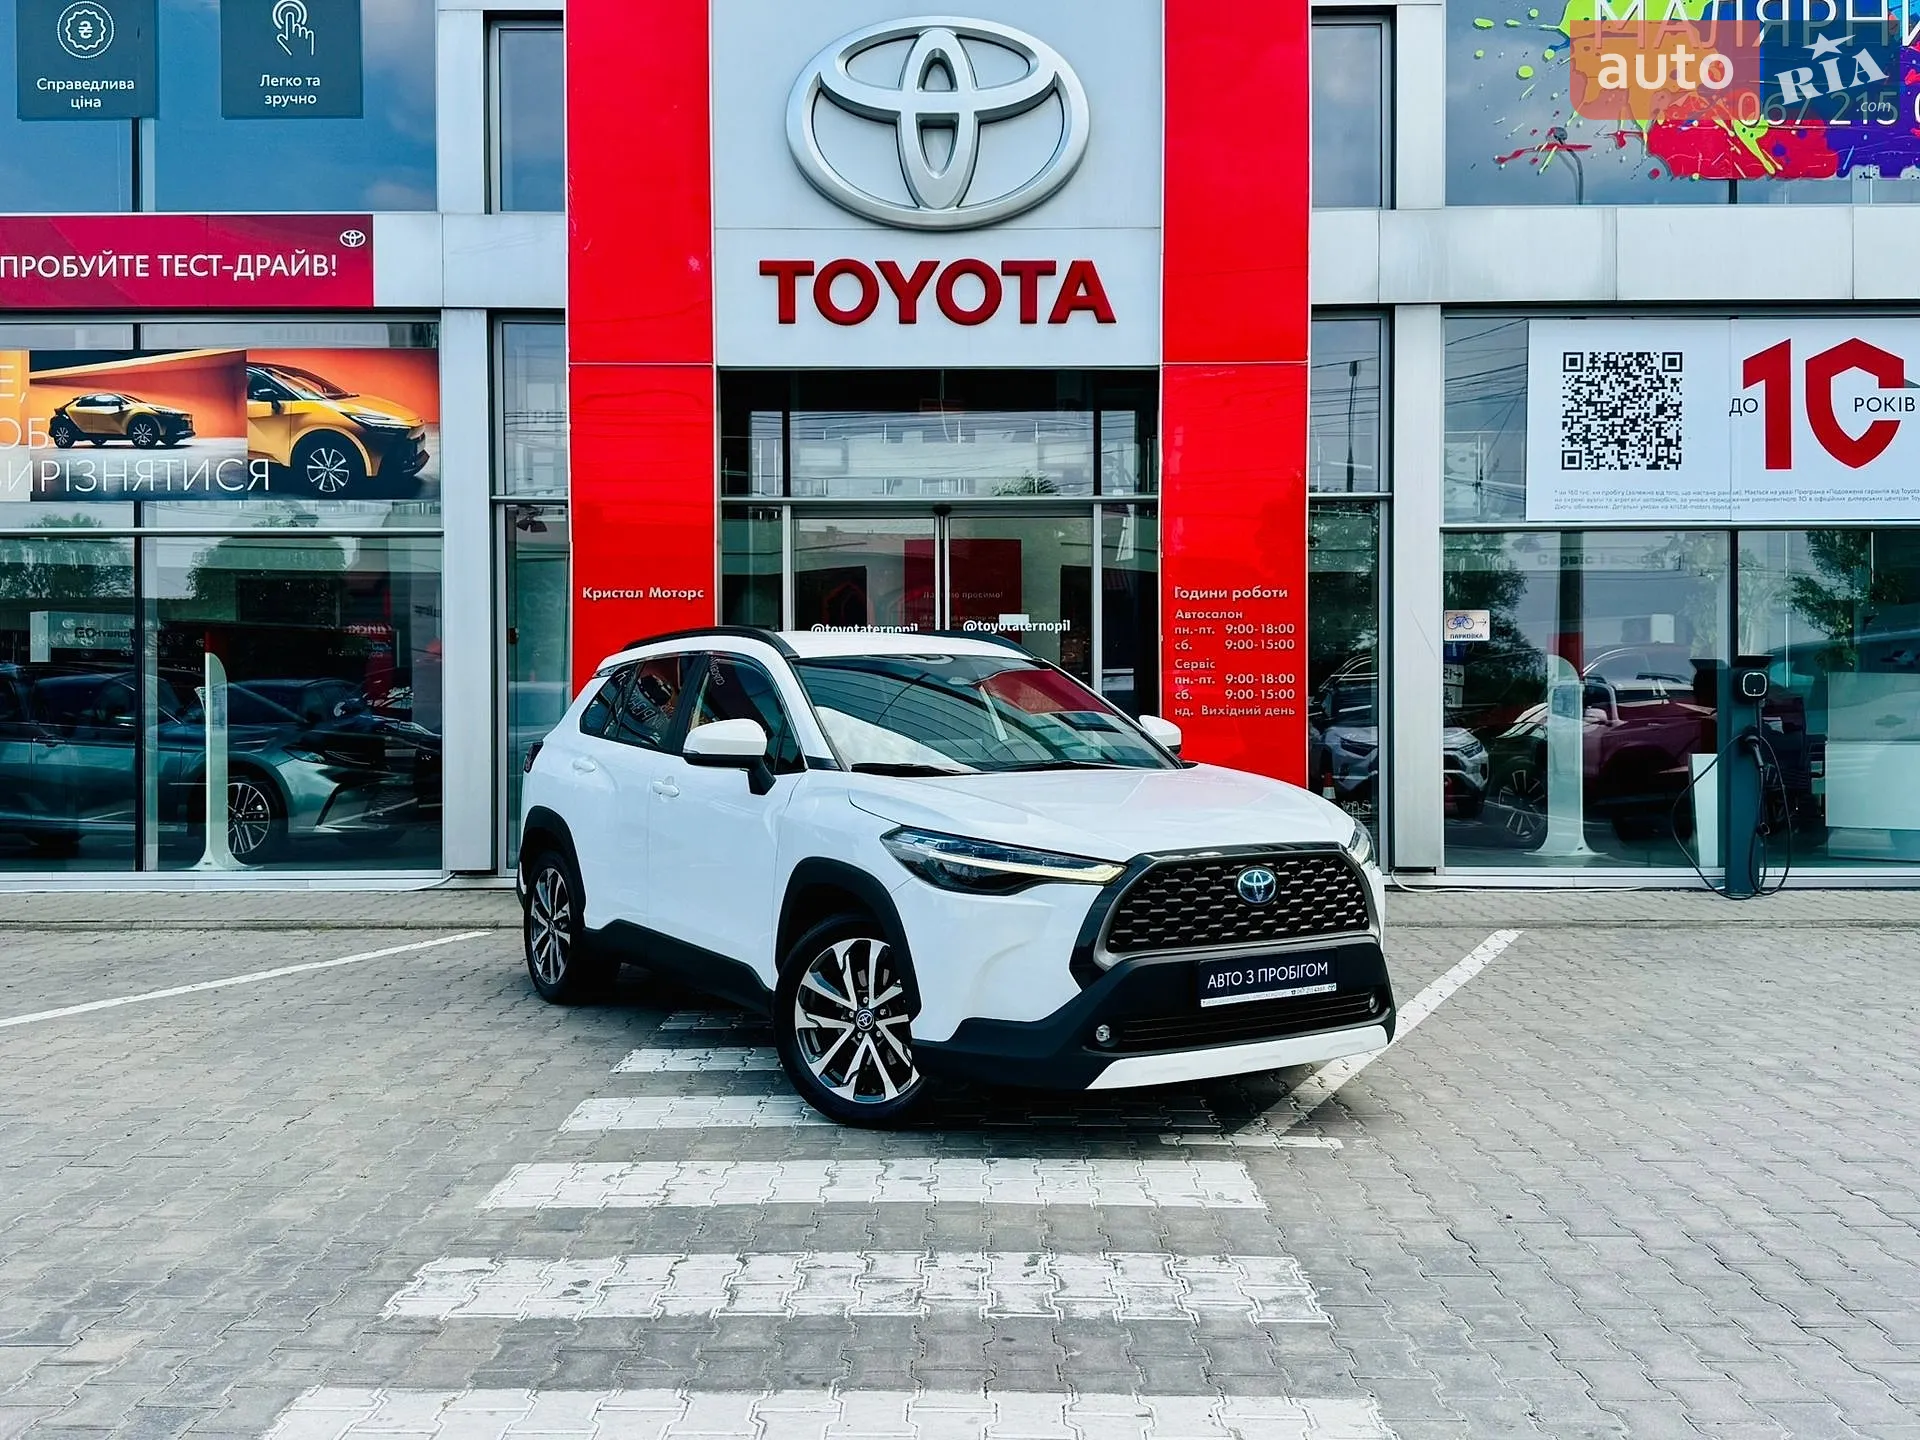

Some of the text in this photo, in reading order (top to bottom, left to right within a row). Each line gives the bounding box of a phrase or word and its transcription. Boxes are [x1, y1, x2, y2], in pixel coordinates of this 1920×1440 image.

[36, 77, 135, 93] Справедлива
[260, 73, 321, 88] Легко та
[70, 95, 102, 110] ціна
[264, 92, 317, 107] зручно
[158, 249, 337, 281] ТЕСТ-ДРАЙВ!
[759, 258, 1117, 326] TOYOTA
[1729, 337, 1916, 470] ДО 10 РОКІВ
[0, 457, 270, 492] ИРІЗНЯТИСЯ
[582, 586, 705, 601] Кристал Моторс
[1174, 585, 1288, 602] Години роботи
[1175, 608, 1243, 620] Автосалон
[963, 619, 1071, 634] @toyotaternopil
[1174, 626, 1216, 635] пн.-пт.
[1174, 639, 1193, 650] сб.
[1175, 658, 1216, 671] Сервіс
[1174, 676, 1216, 685] пн.-пт.
[1174, 689, 1193, 700] сб.
[1174, 704, 1296, 717] нд. Вихідний день
[1207, 961, 1328, 989] АВТО З ПРОБІГОМ
